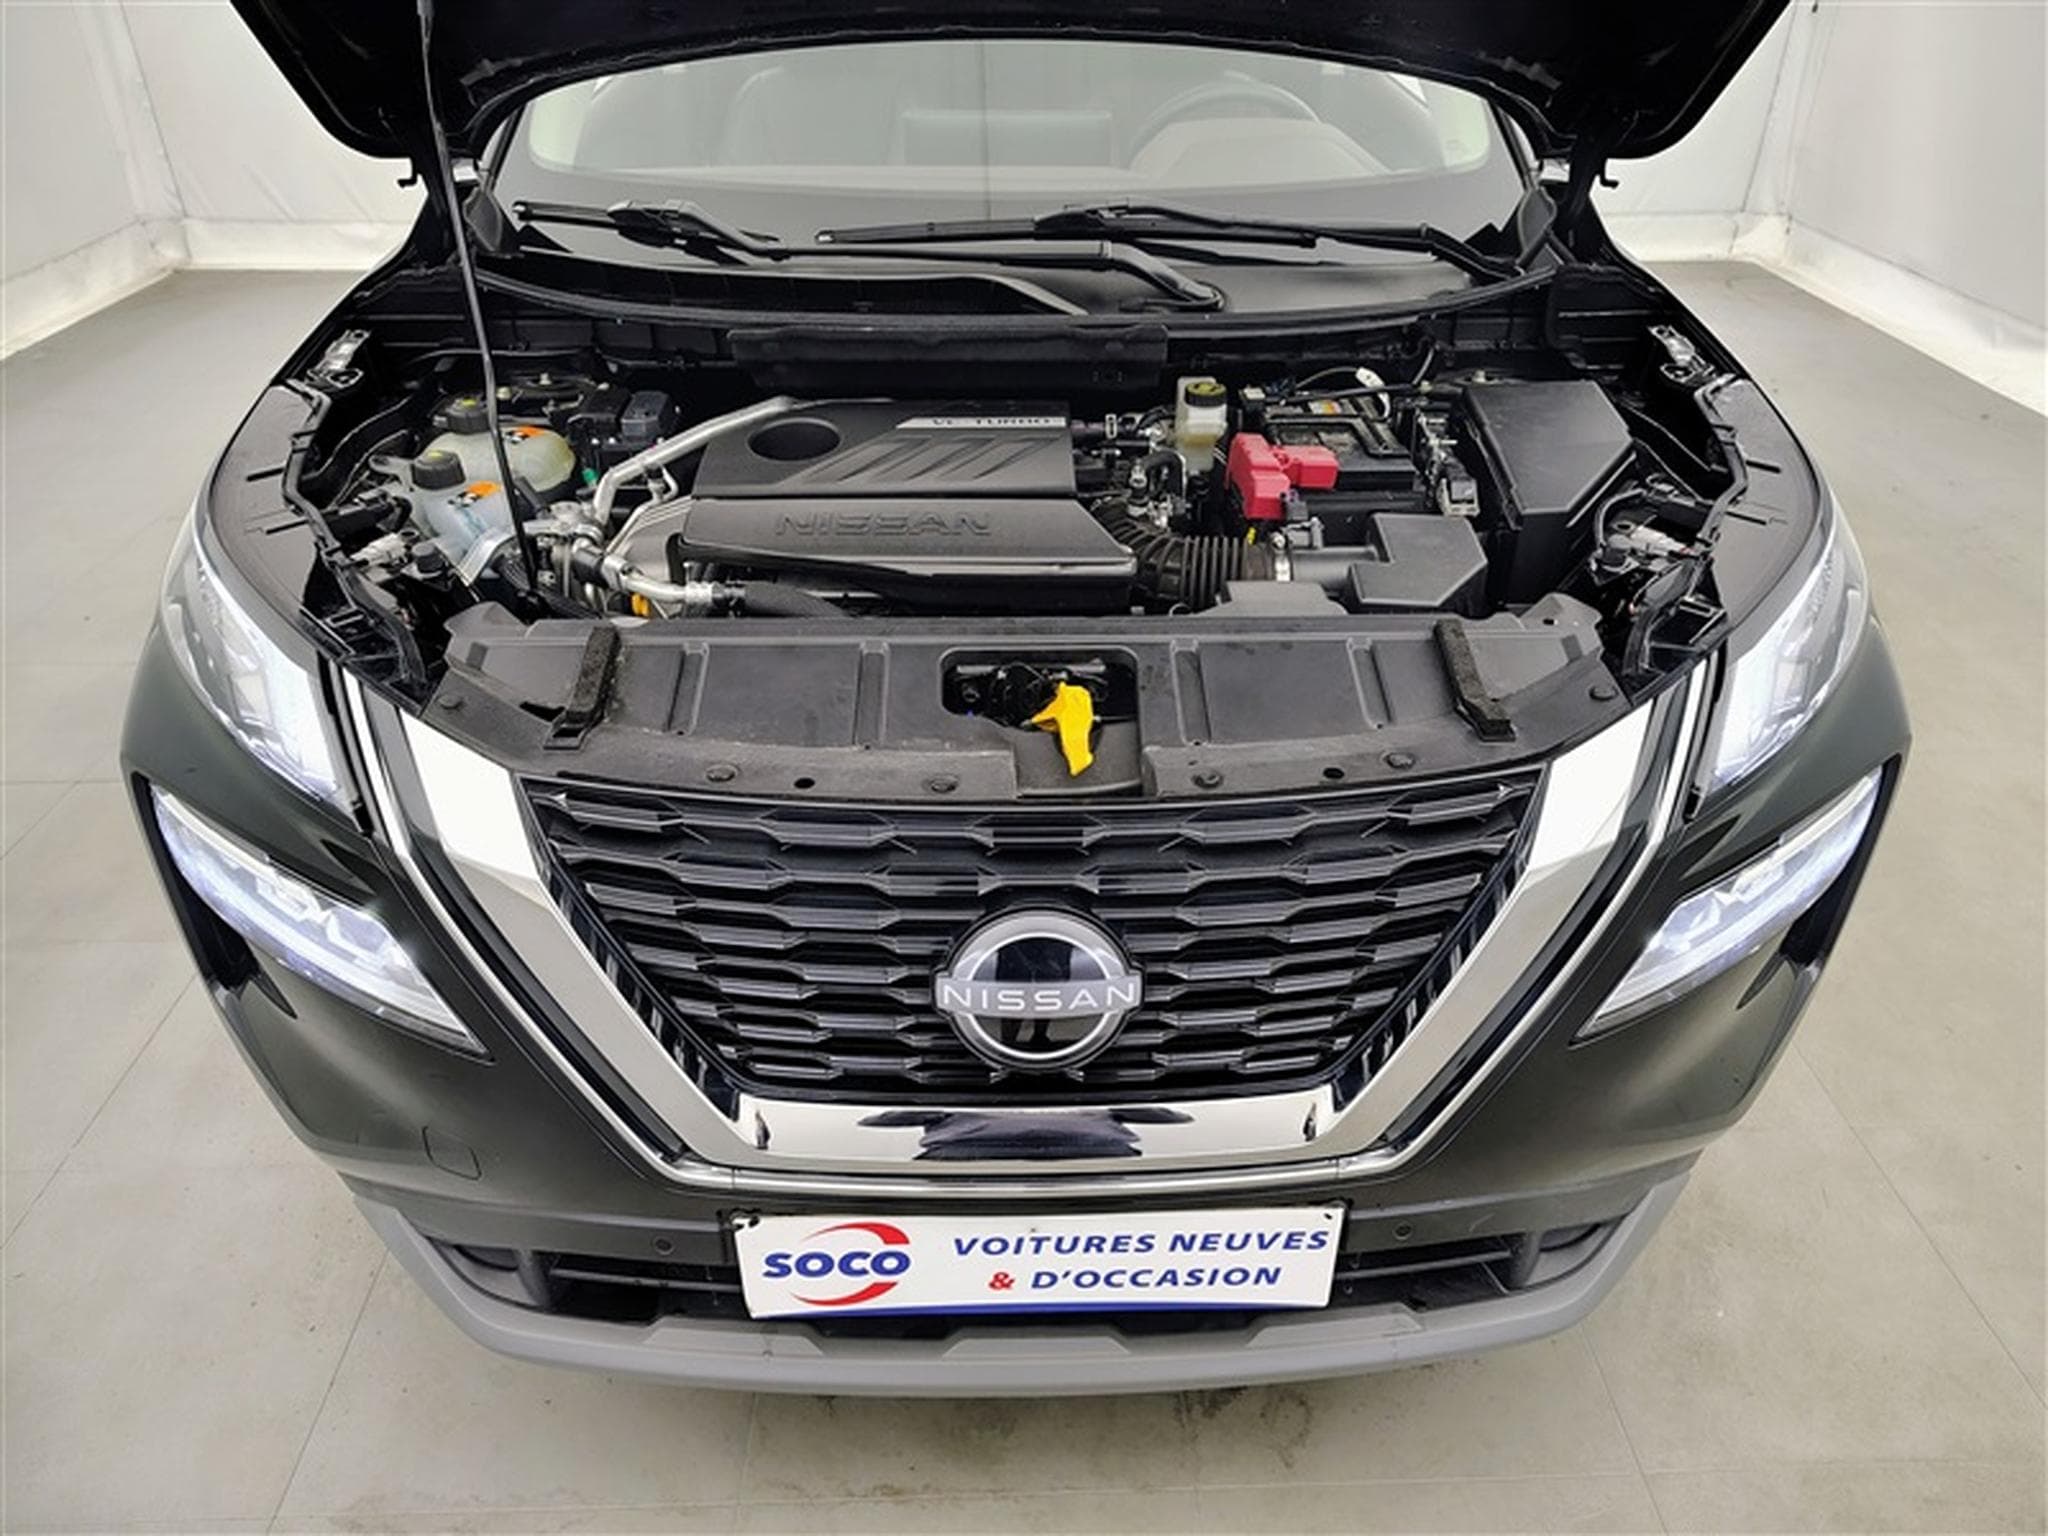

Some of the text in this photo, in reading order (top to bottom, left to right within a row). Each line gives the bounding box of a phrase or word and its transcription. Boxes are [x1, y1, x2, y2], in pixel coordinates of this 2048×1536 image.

[775, 511, 992, 536] NISSAN
[943, 982, 1135, 1011] NISSAN
[953, 1230, 1329, 1256] VOITURES NEUVES
[762, 1251, 911, 1278] SOCO
[988, 1272, 1015, 1290] &
